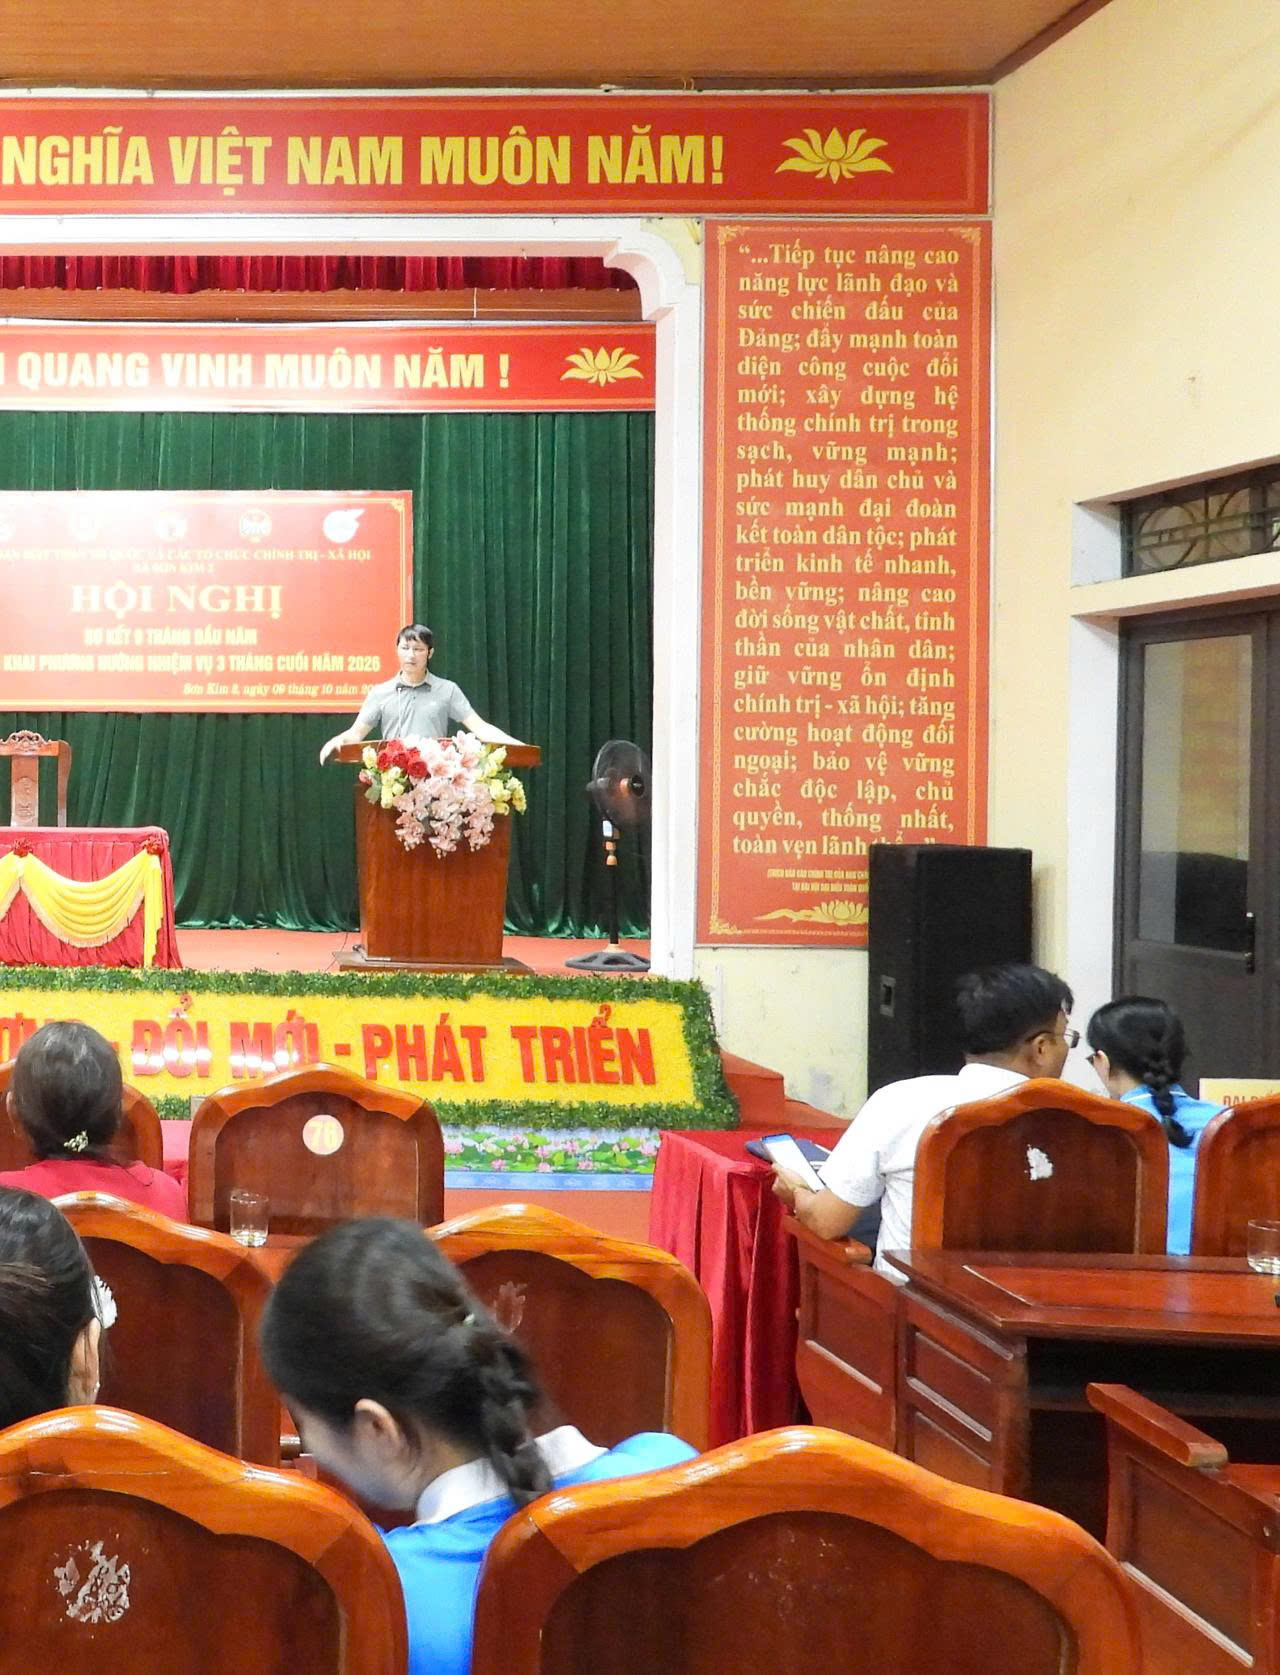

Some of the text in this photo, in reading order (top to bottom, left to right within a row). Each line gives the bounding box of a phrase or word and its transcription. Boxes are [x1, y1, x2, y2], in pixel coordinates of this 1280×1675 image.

[2, 126, 154, 186] NGHĨA
[169, 127, 272, 196] VIỆT
[286, 136, 403, 186] NAM
[421, 126, 571, 186] MUÔN
[588, 124, 724, 186] NĂM!
[824, 247, 855, 269] tục
[865, 244, 916, 269] nâng
[924, 250, 959, 264] cao
[739, 272, 959, 297] năng lực lãnh đạo và
[738, 295, 958, 320] sức chiến đấu của
[738, 322, 958, 353] Đảng; đẩy mạnh toàn
[19, 352, 149, 389] QUANG
[160, 353, 244, 389] VINH
[264, 347, 381, 389] MUÔN
[394, 344, 484, 389] NĂM
[499, 353, 509, 388] !
[737, 468, 957, 493] phát huy dân chủ và
[70, 580, 282, 620] HỘI NGHỊ
[735, 603, 955, 635] đời sống vật chất, tinh
[196, 655, 214, 676] VỤ
[216, 655, 225, 672] 3
[230, 652, 273, 672] THÁNG
[277, 650, 308, 672] CUỐI
[312, 652, 344, 672] NĂM
[206, 683, 229, 695] Kim
[733, 717, 955, 749] cường hoạt động đối
[132, 992, 212, 1078] ĐỔI
[229, 1009, 320, 1080] MỚI
[360, 1012, 487, 1083] PHÁT
[510, 1004, 656, 1085] TRIỂN
